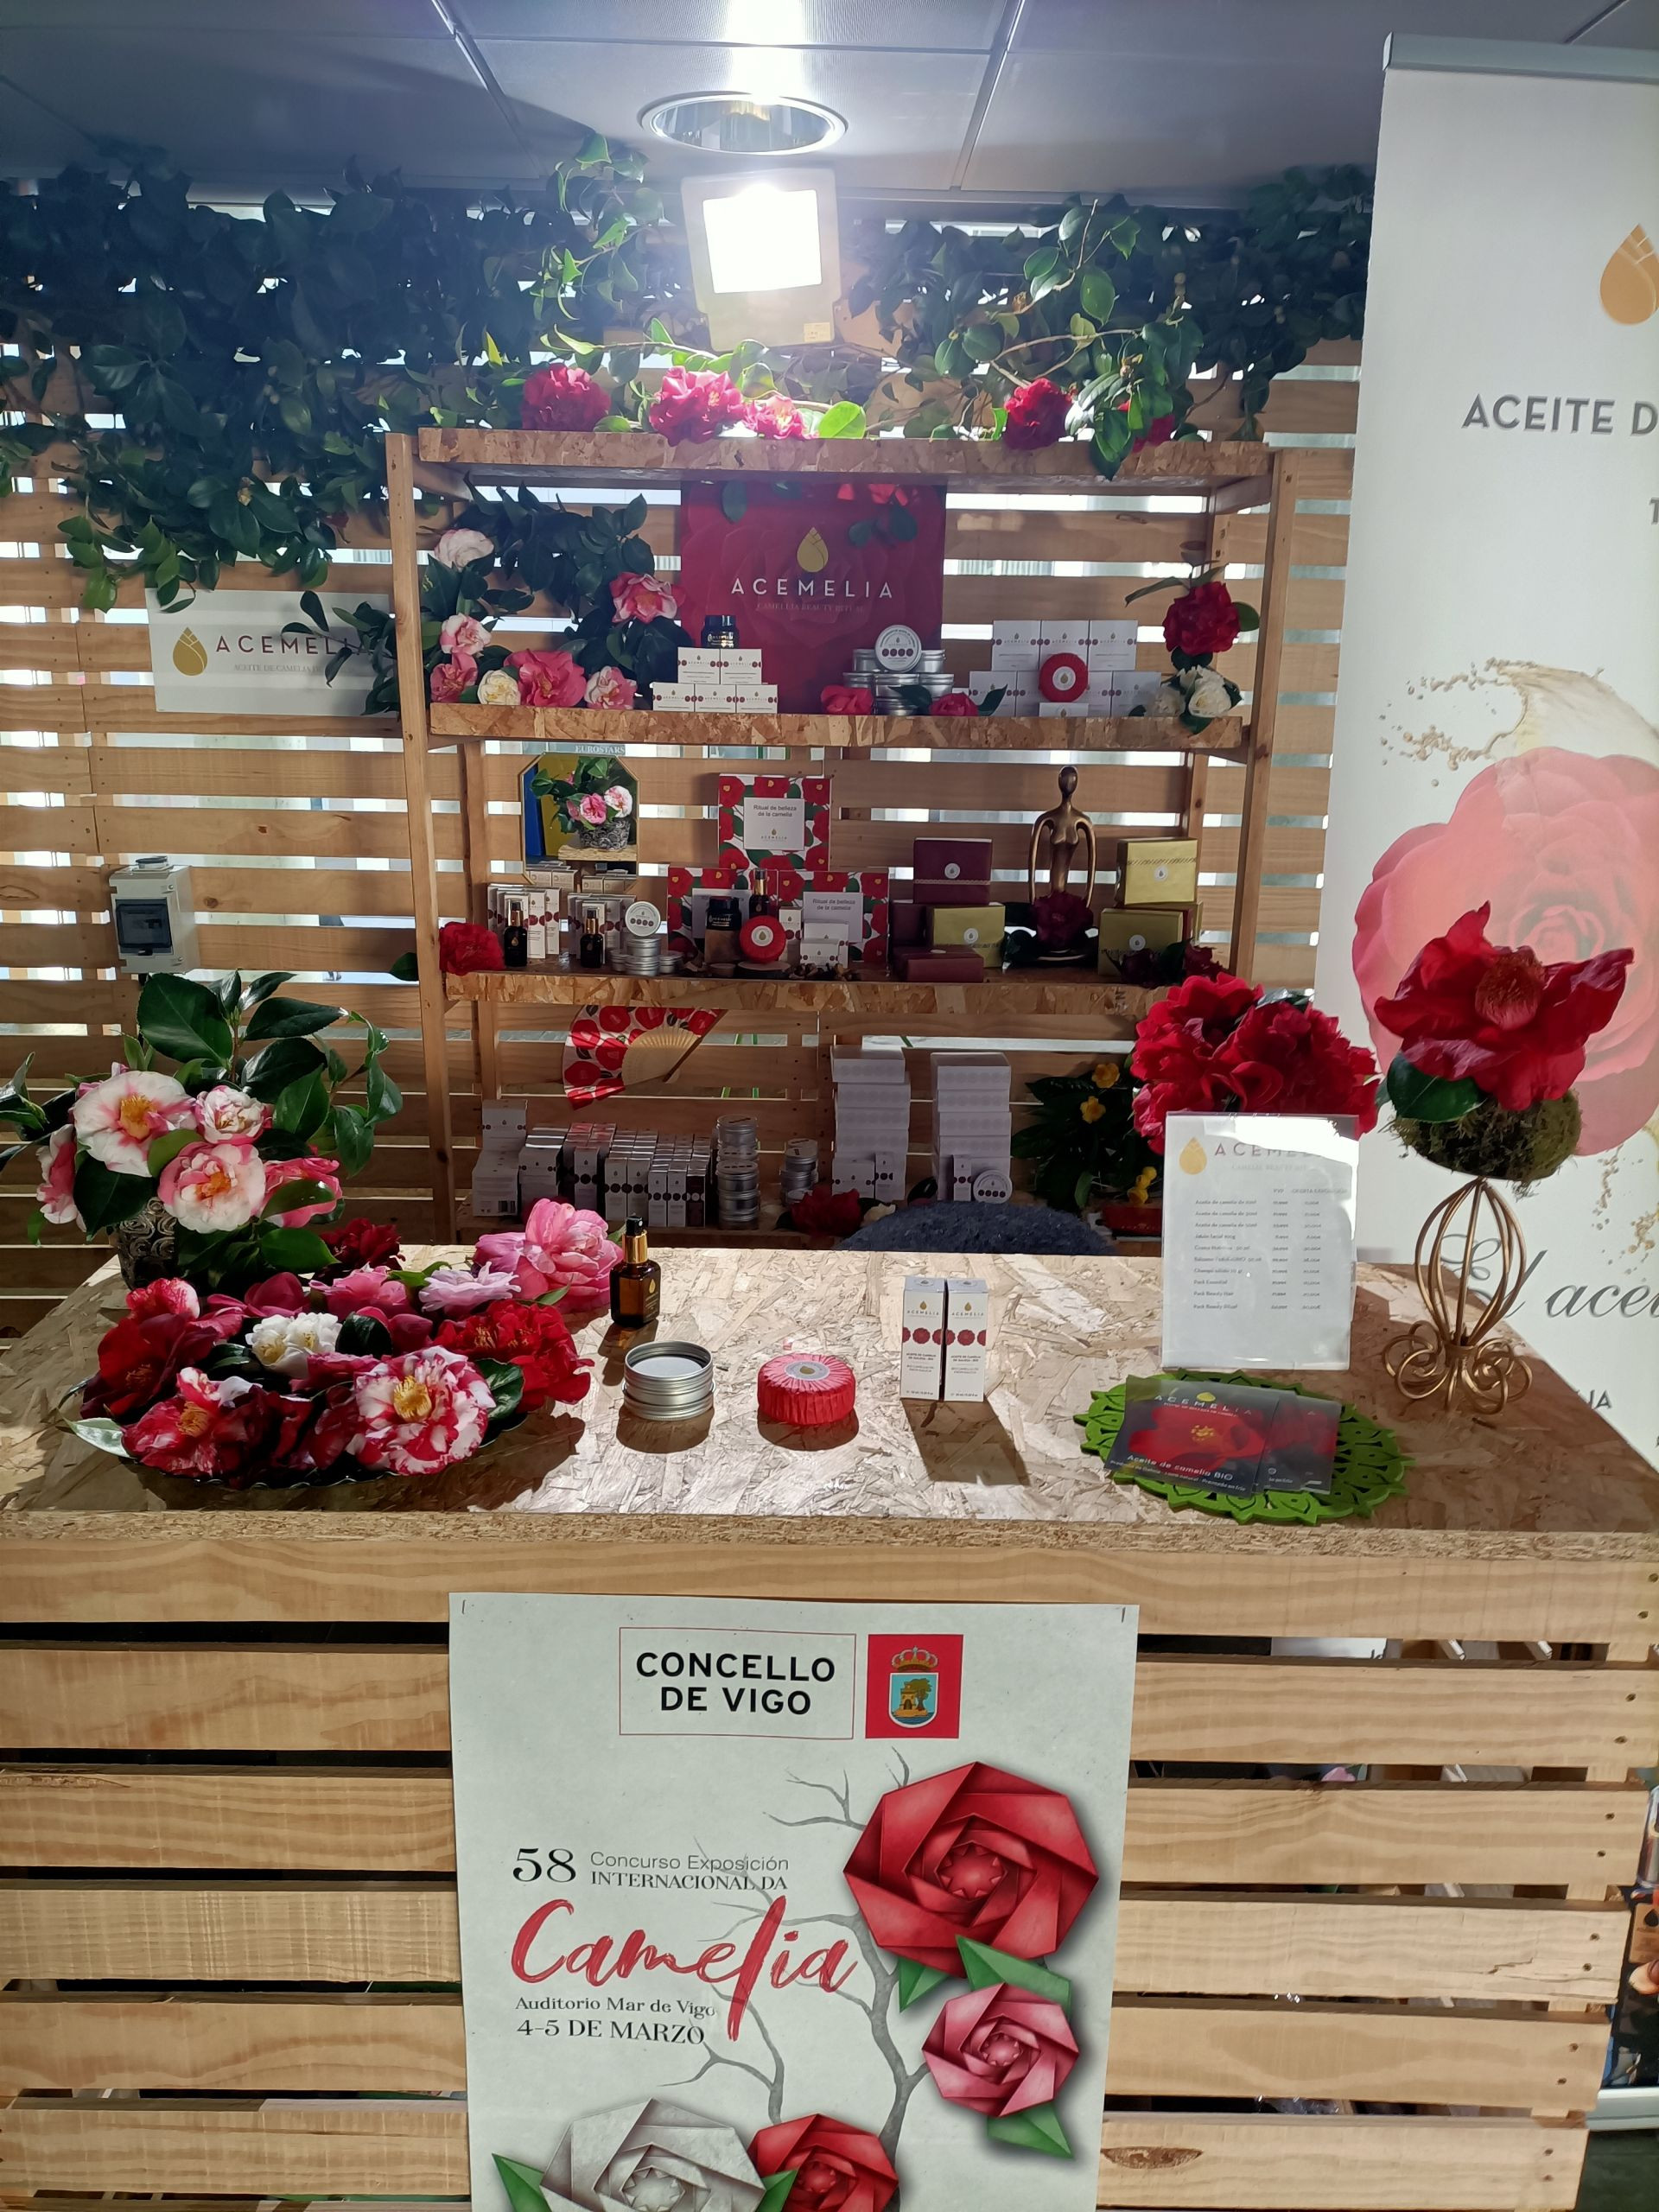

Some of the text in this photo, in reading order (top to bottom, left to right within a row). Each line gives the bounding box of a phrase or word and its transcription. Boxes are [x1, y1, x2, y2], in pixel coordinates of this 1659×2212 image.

[1461, 393, 1616, 435] ACEITE
[731, 577, 893, 599] ACEMELIA
[575, 744, 625, 754] EUROSTARS
[1154, 1394, 1252, 1416] ACEMELIA
[1127, 1454, 1157, 1466] Aceite
[1160, 1460, 1172, 1469] de
[1174, 1464, 1211, 1477] camelia
[1213, 1471, 1233, 1481] BIO
[636, 1651, 836, 1682] CONCELLO
[660, 1686, 811, 1715] DE VIGO
[512, 1847, 789, 1884] 58 Concurso Exposición
[591, 1871, 788, 1891] INTERNACIONAL DA
[512, 1895, 858, 2043] Camelia
[515, 1996, 715, 2019] Auditorio Mar de Vigo
[568, 2018, 602, 2037] DE
[610, 2020, 705, 2045] MARZO
